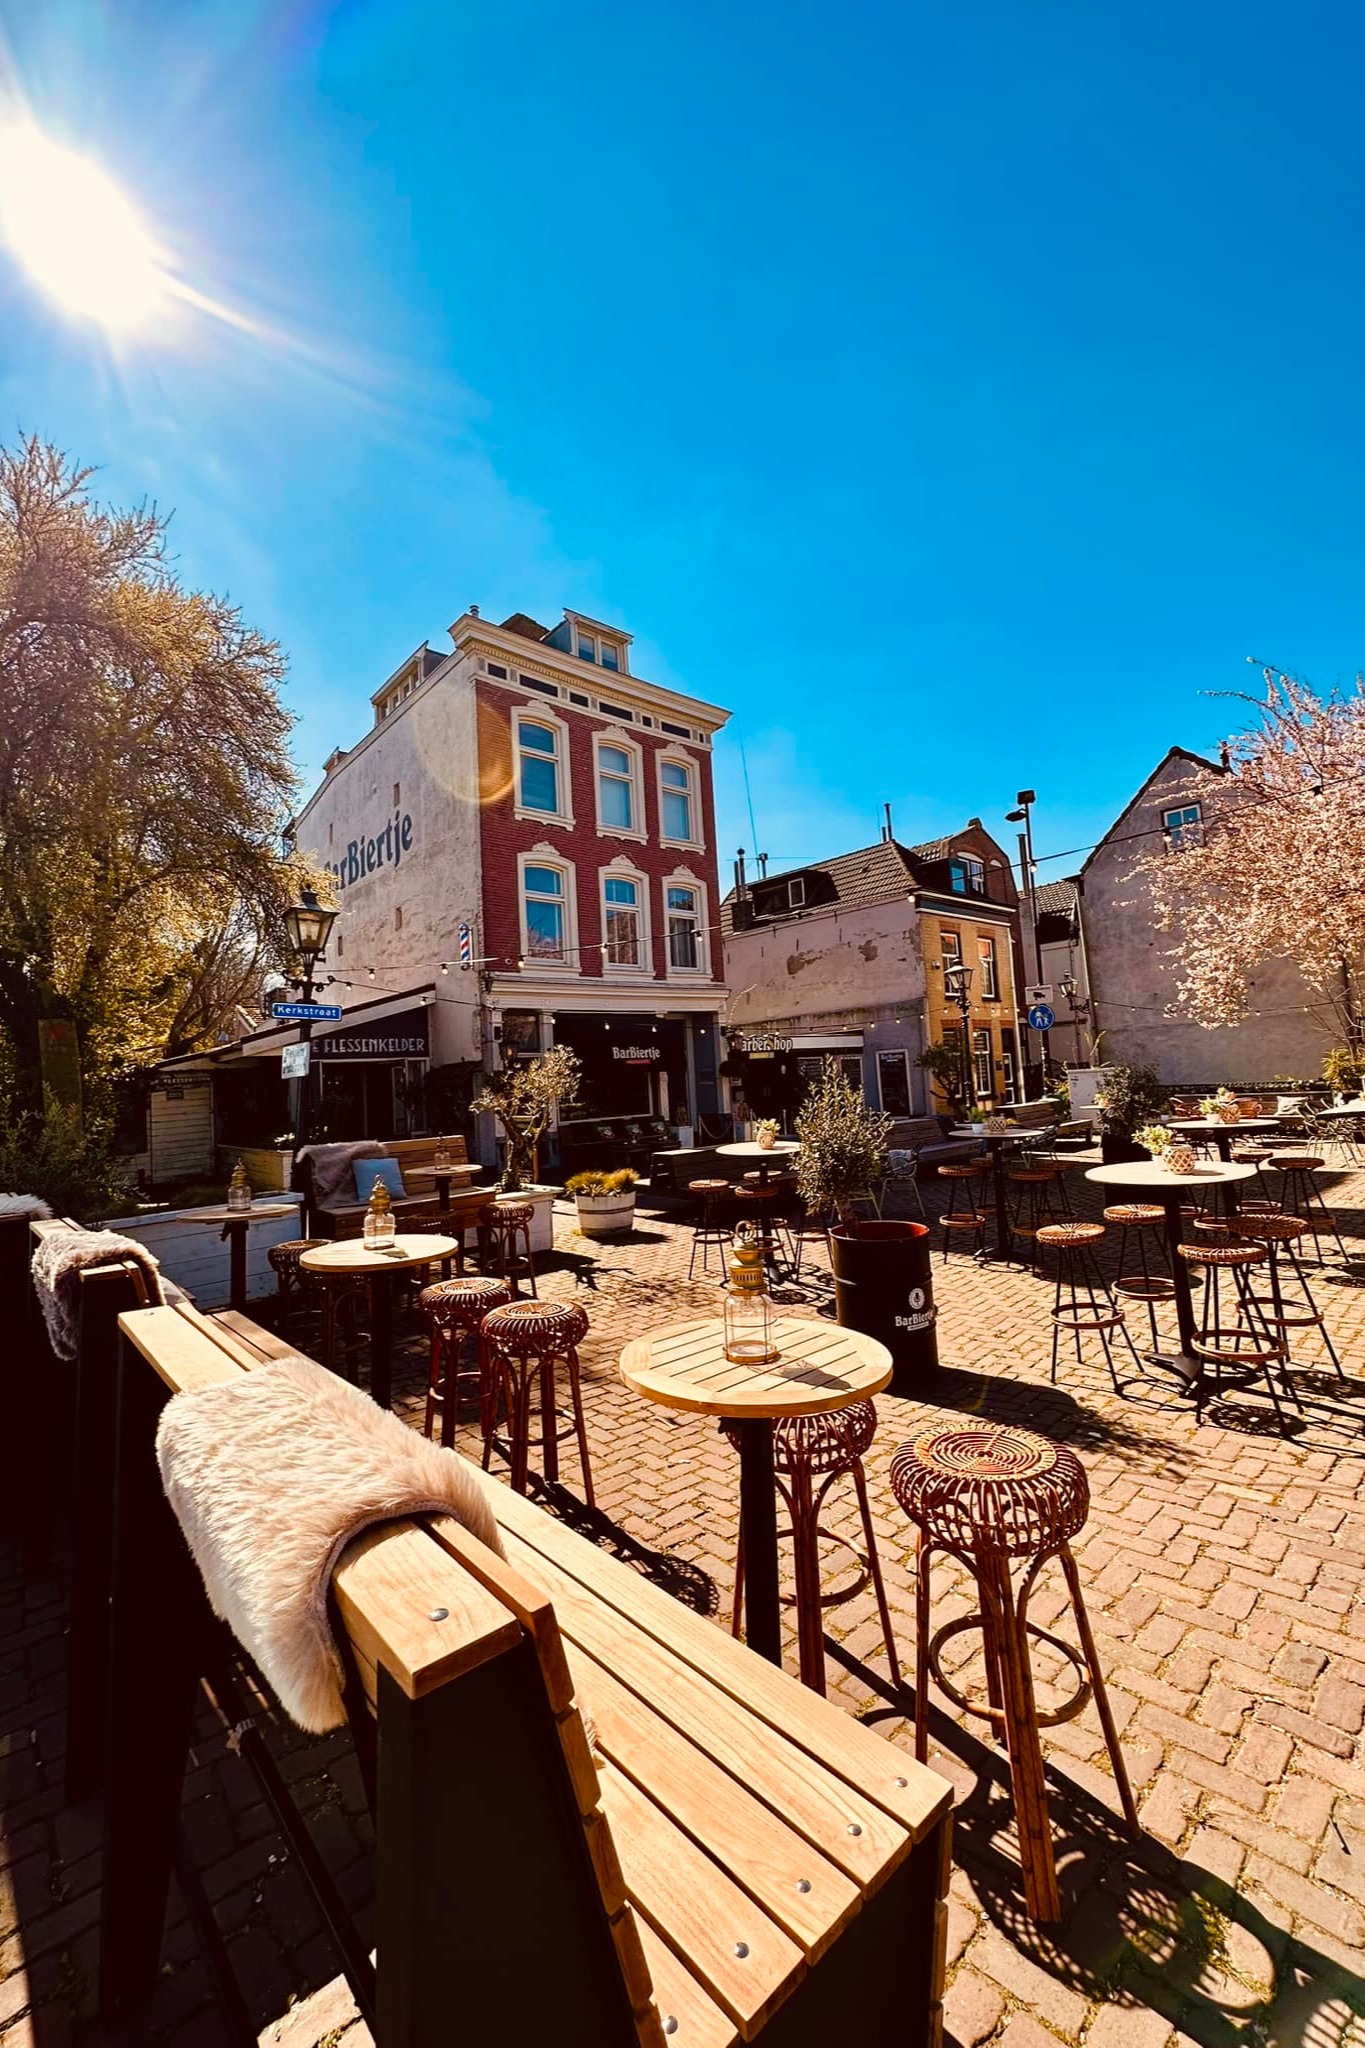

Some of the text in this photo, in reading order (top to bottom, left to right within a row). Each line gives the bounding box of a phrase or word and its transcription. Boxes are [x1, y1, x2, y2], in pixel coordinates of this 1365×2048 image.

[277, 1005, 337, 1017] Kerkstraat
[324, 1038, 425, 1053] FLESSENKELDER
[611, 1046, 661, 1060] BarBiertje
